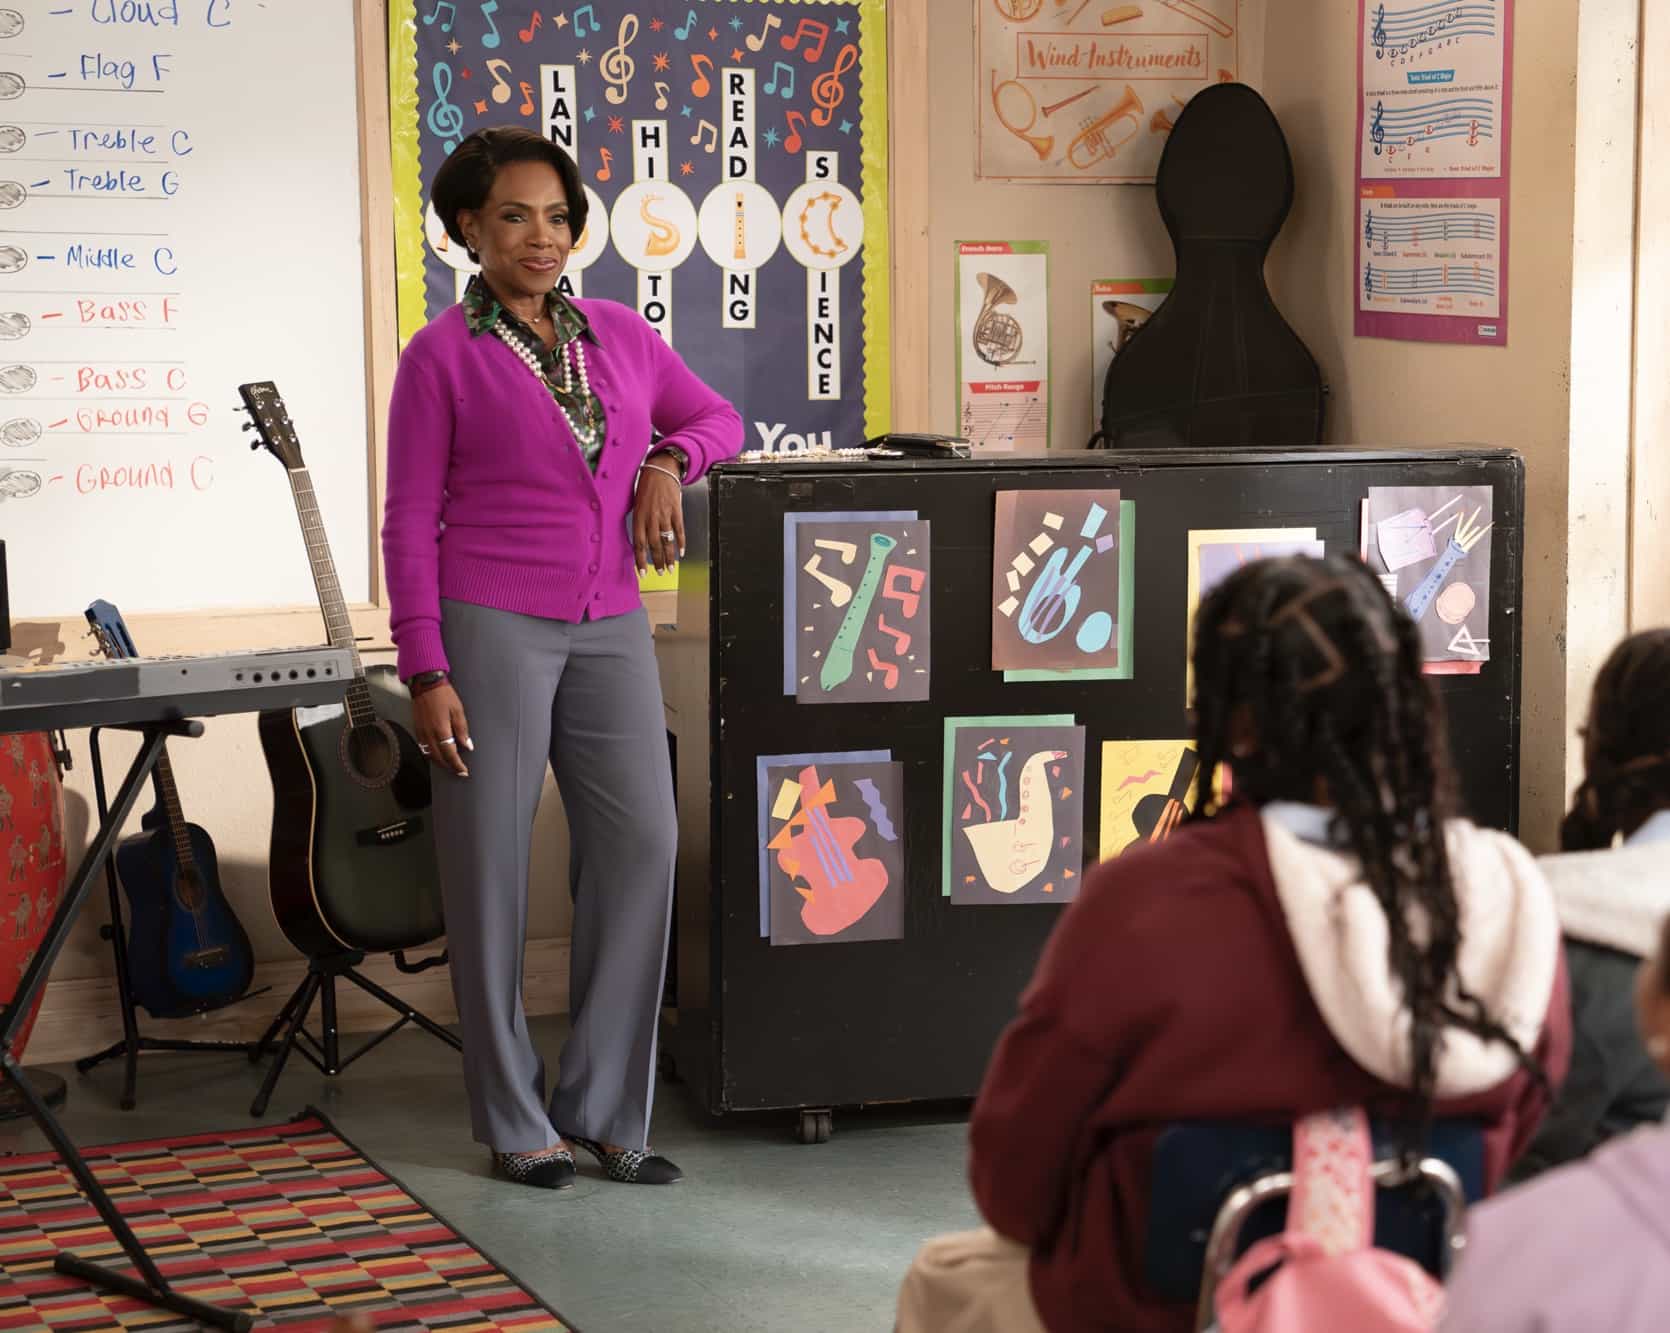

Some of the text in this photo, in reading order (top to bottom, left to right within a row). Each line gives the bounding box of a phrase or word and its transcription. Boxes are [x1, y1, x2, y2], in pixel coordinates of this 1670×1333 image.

[91, 0, 231, 27] Cloud C
[1027, 39, 1202, 70] Wind Instruments
[81, 53, 172, 89] Flag F
[68, 129, 193, 156] Treble C
[64, 168, 180, 195] Treble G
[67, 245, 178, 275] Middle C
[77, 300, 147, 322] Bass
[77, 367, 187, 392] Bass C
[187, 401, 209, 426] G
[754, 422, 832, 452] You
[190, 455, 214, 490] C
